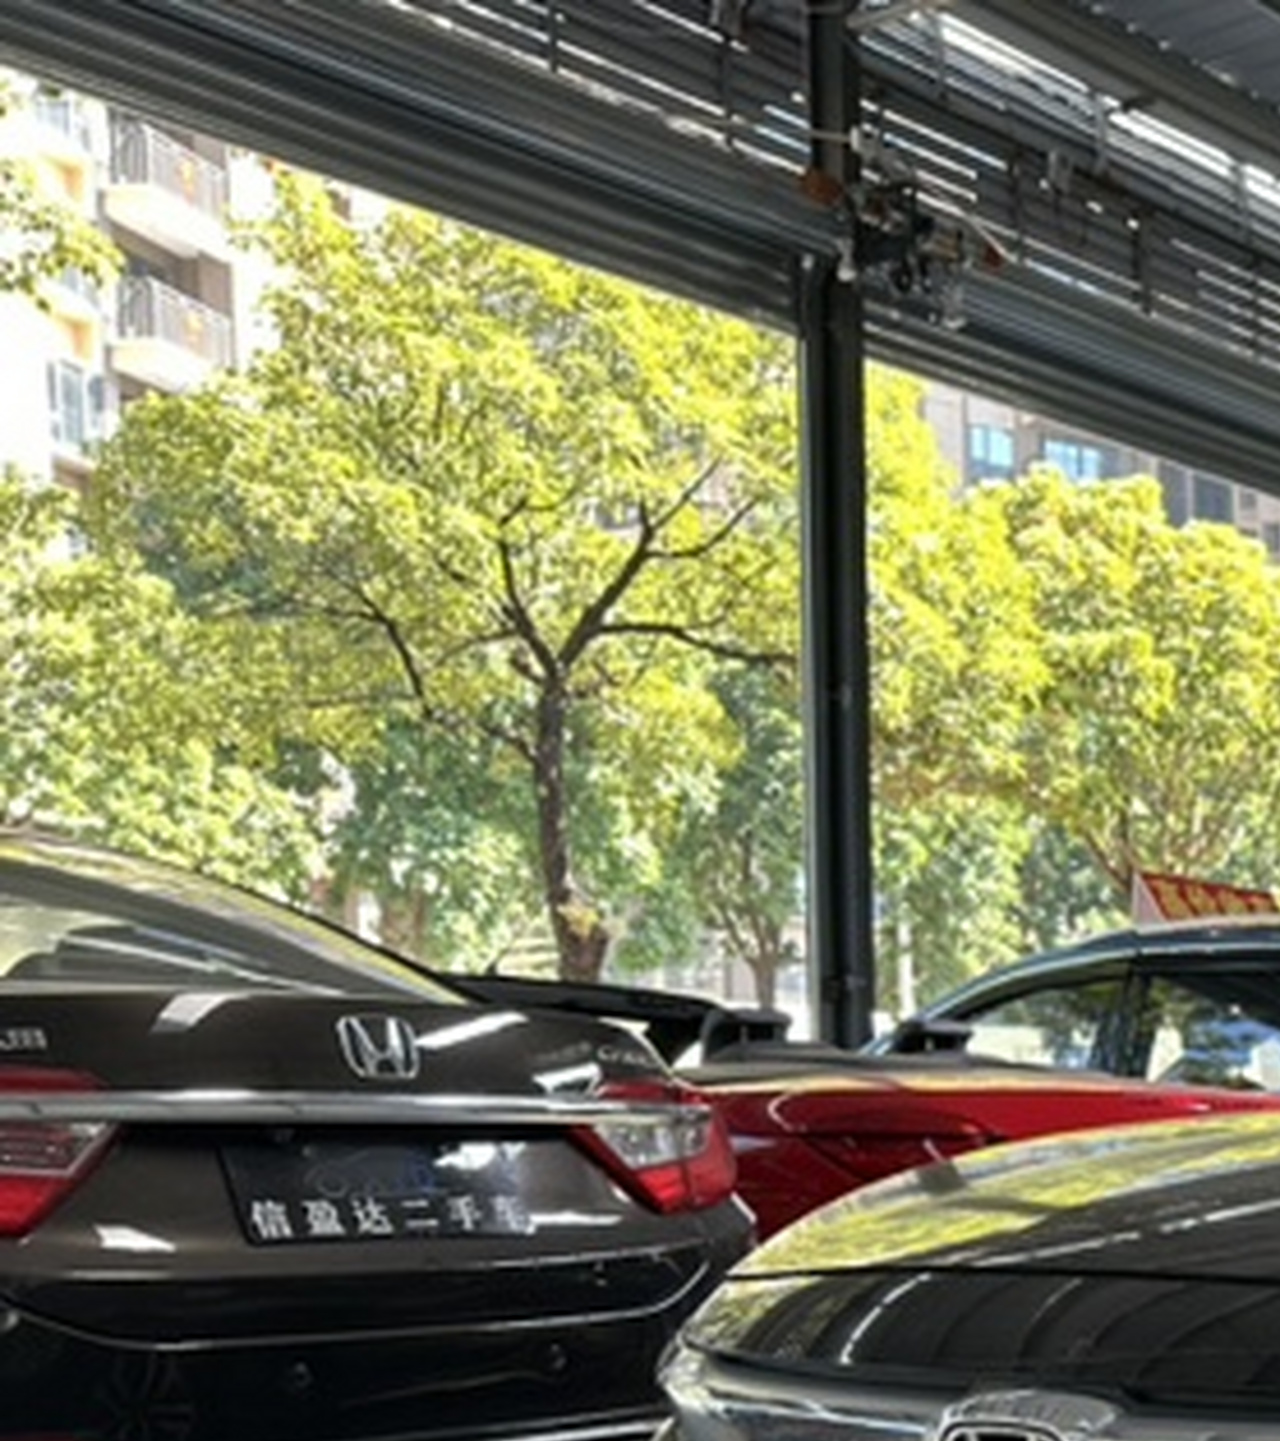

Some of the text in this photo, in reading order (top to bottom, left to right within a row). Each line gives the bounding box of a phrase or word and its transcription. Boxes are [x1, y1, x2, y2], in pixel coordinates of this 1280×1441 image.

[251, 1196, 536, 1240] 信盈达二手车
